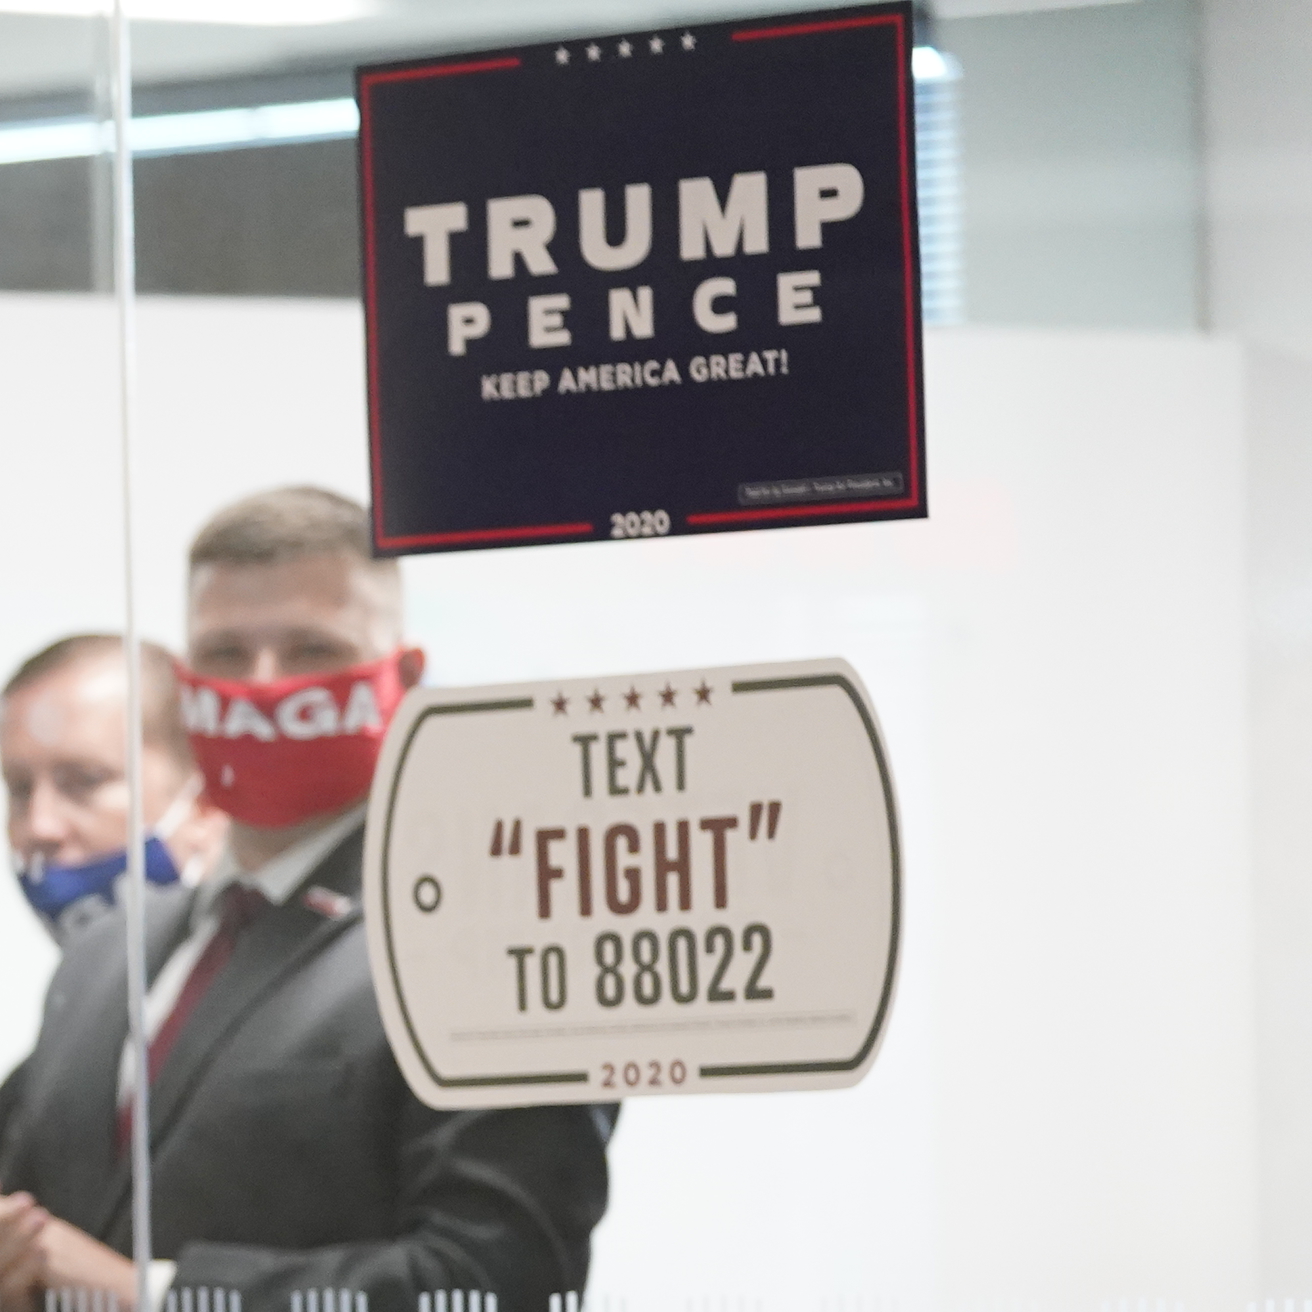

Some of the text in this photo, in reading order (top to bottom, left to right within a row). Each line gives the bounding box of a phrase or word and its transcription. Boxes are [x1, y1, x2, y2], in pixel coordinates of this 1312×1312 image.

[404, 162, 865, 287] TRUMP
[447, 270, 822, 356] PENCE
[481, 348, 789, 402] KEEP AMERICA GREAT!
[609, 510, 672, 539] 2020
[179, 680, 383, 743] MAGA
[572, 726, 694, 798] TEXT
[507, 922, 775, 1013] TO 88022
[601, 1059, 688, 1089] 2020
